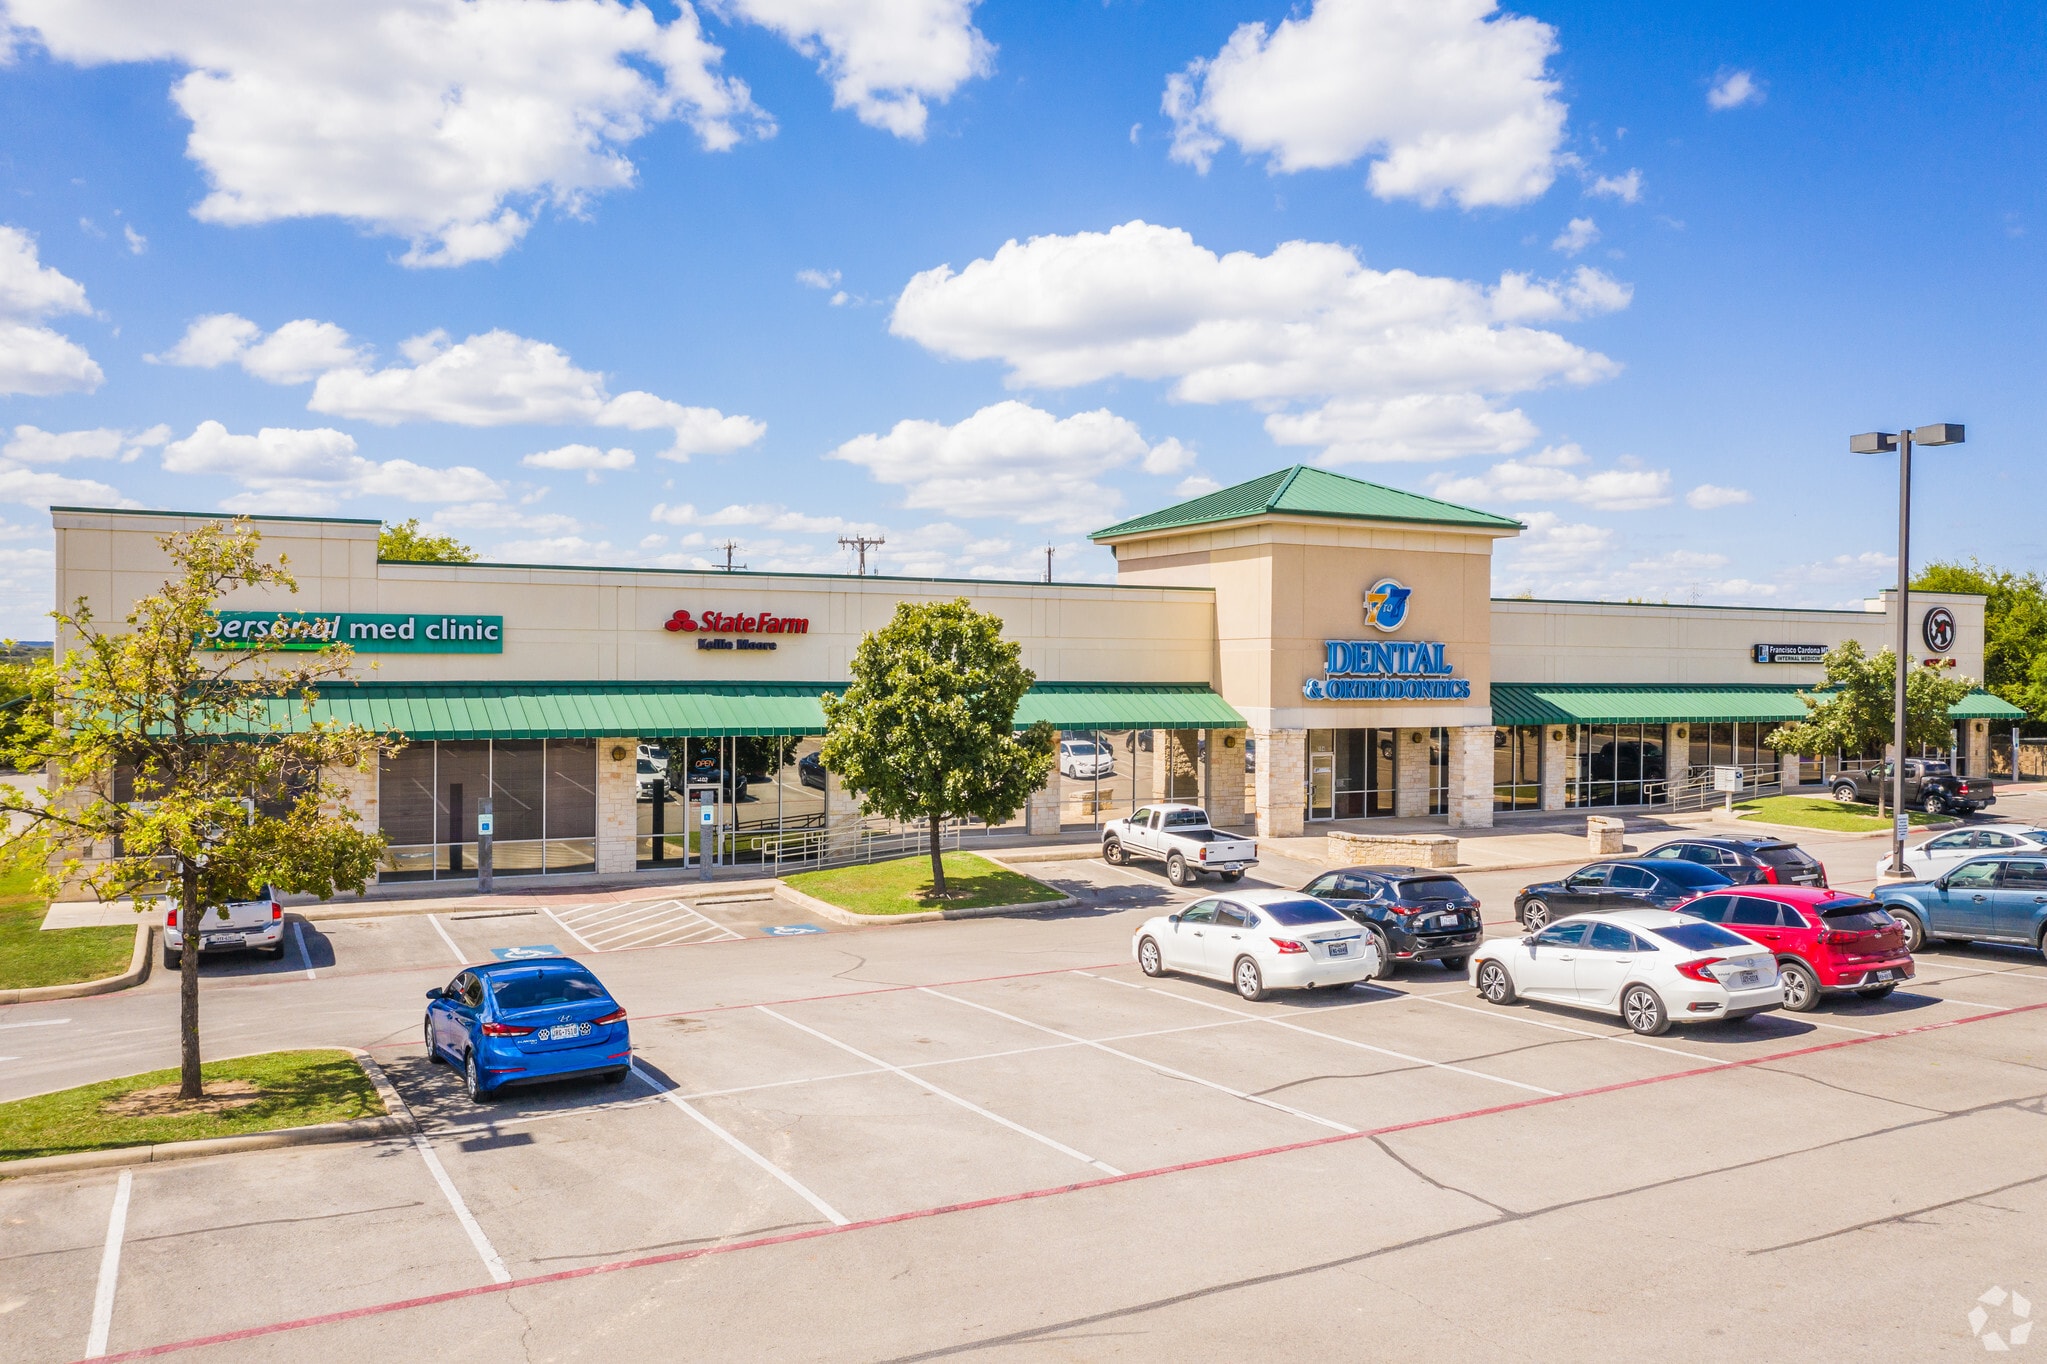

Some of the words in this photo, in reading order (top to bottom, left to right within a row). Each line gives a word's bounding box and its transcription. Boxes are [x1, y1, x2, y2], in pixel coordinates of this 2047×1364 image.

[1367, 593, 1388, 623] 7
[1390, 588, 1412, 618] 7
[349, 616, 414, 640] med
[424, 617, 499, 641] clinic
[697, 639, 733, 651] Kellie
[736, 638, 777, 651] Moore
[1769, 646, 1797, 654] Francisco
[1797, 646, 1821, 654] Cardona
[1326, 640, 1453, 676] DENTAL
[1305, 679, 1325, 699] &
[1326, 679, 1471, 699] ORTHODONTICS
